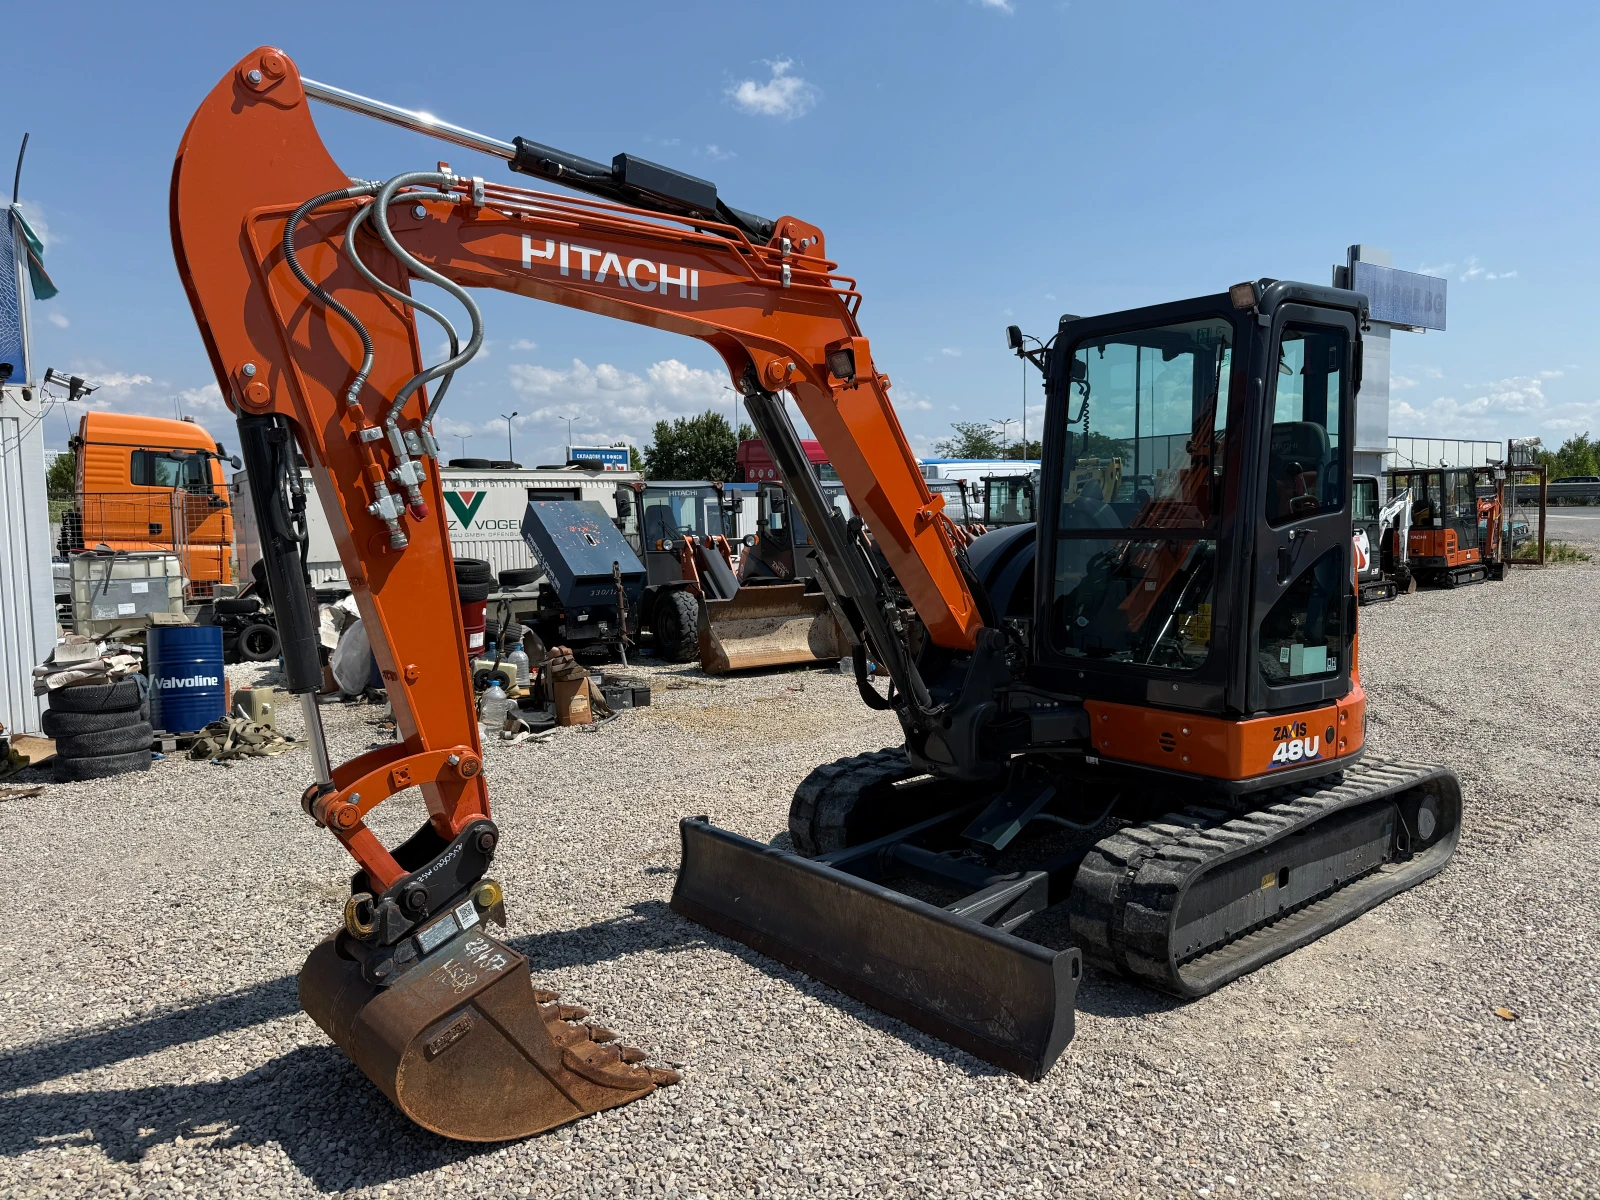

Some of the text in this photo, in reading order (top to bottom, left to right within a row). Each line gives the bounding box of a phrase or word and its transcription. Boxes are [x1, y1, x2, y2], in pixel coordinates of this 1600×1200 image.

[522, 234, 698, 301] HITACHI
[155, 675, 219, 690] Valvoline
[1273, 720, 1307, 742] ZAXIS
[1272, 735, 1320, 763] 48U
